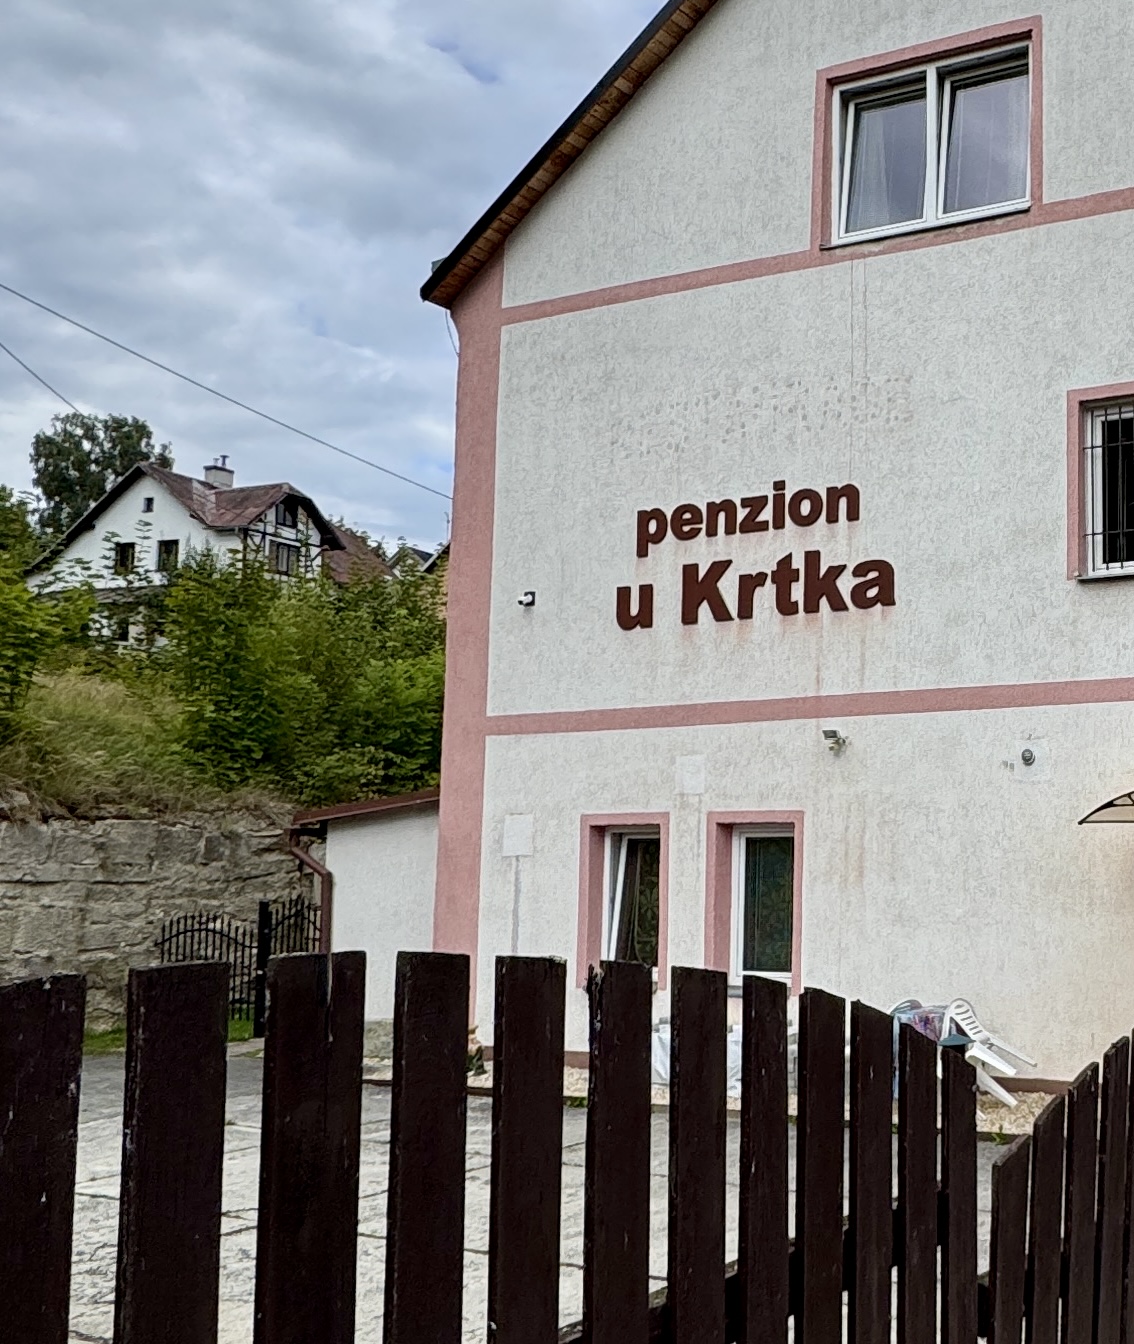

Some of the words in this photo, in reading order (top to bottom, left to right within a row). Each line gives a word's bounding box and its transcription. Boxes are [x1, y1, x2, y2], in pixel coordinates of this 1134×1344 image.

[636, 479, 860, 558] penzion
[616, 583, 653, 631] u
[681, 549, 896, 625] Krtka
